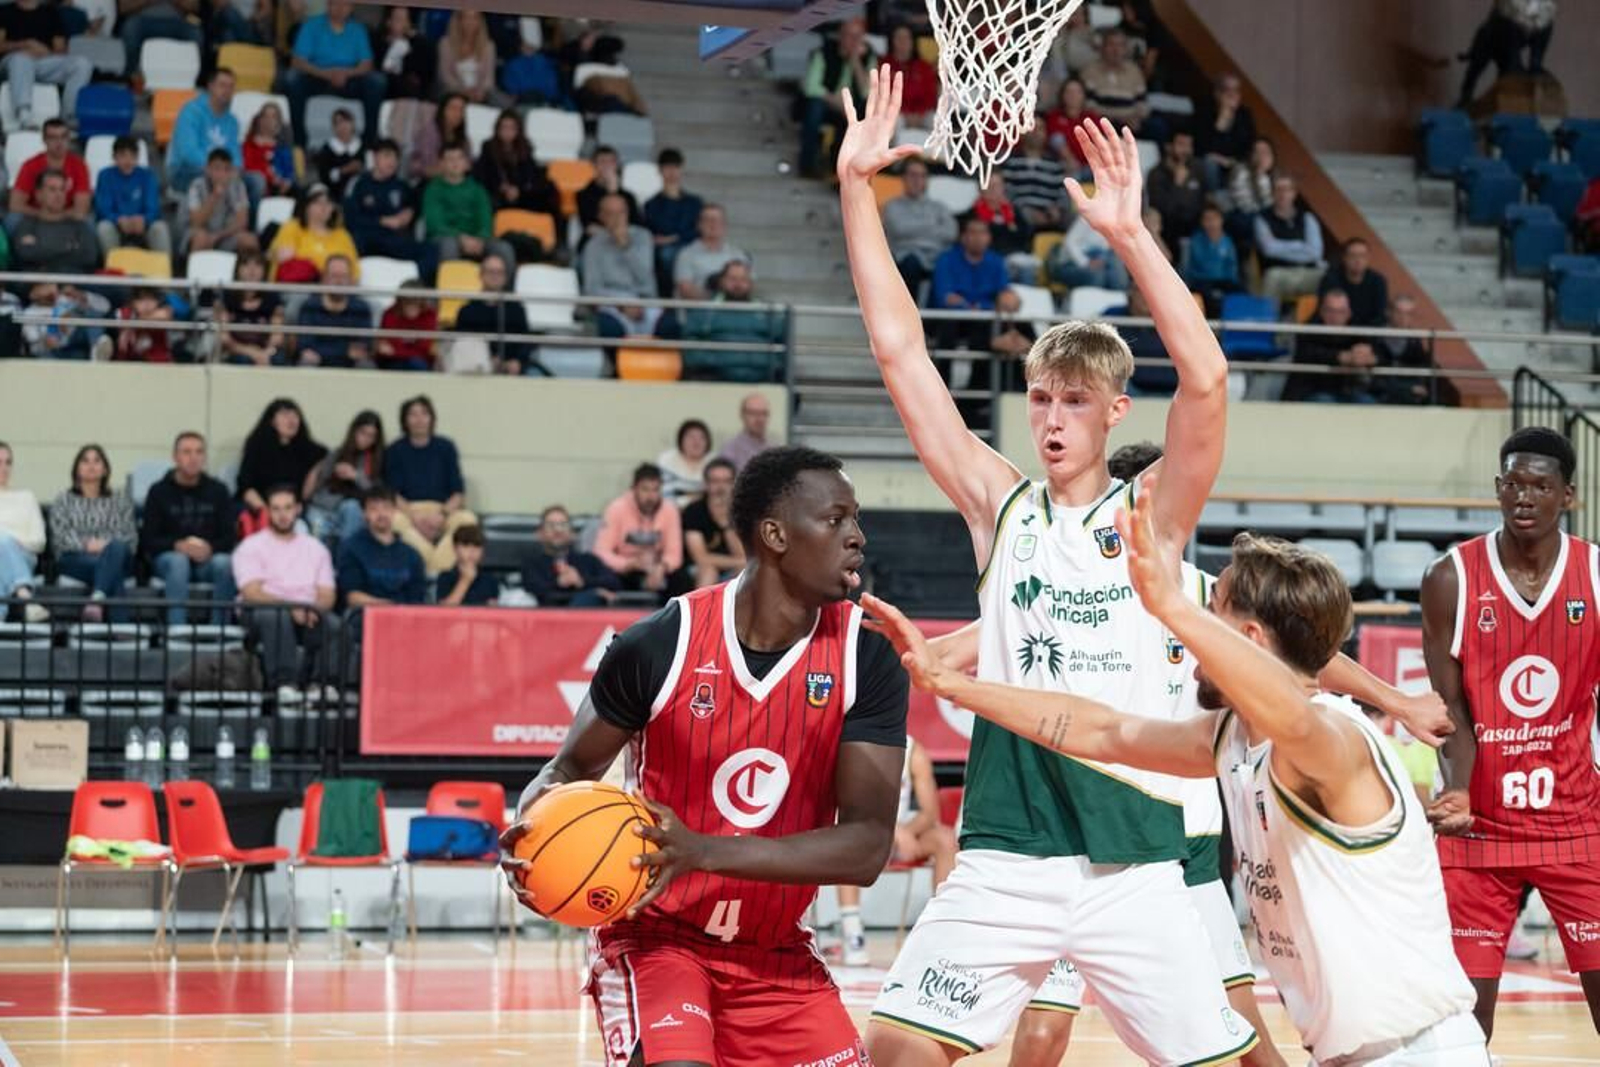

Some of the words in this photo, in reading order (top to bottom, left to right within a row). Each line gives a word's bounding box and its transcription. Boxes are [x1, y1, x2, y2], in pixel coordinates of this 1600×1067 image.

[1043, 583, 1133, 605] Fundación
[1048, 604, 1109, 629] Unicaja
[1069, 649, 1122, 662] Alhaurín
[1069, 662, 1083, 672] de
[1087, 663, 1098, 672] la
[1102, 662, 1132, 672] Torre
[807, 673, 832, 684] LIGA
[1502, 741, 1553, 756] ZARGOZA
[1502, 767, 1555, 809] 60
[704, 899, 742, 942] 4
[917, 997, 961, 1020] DENTAL
